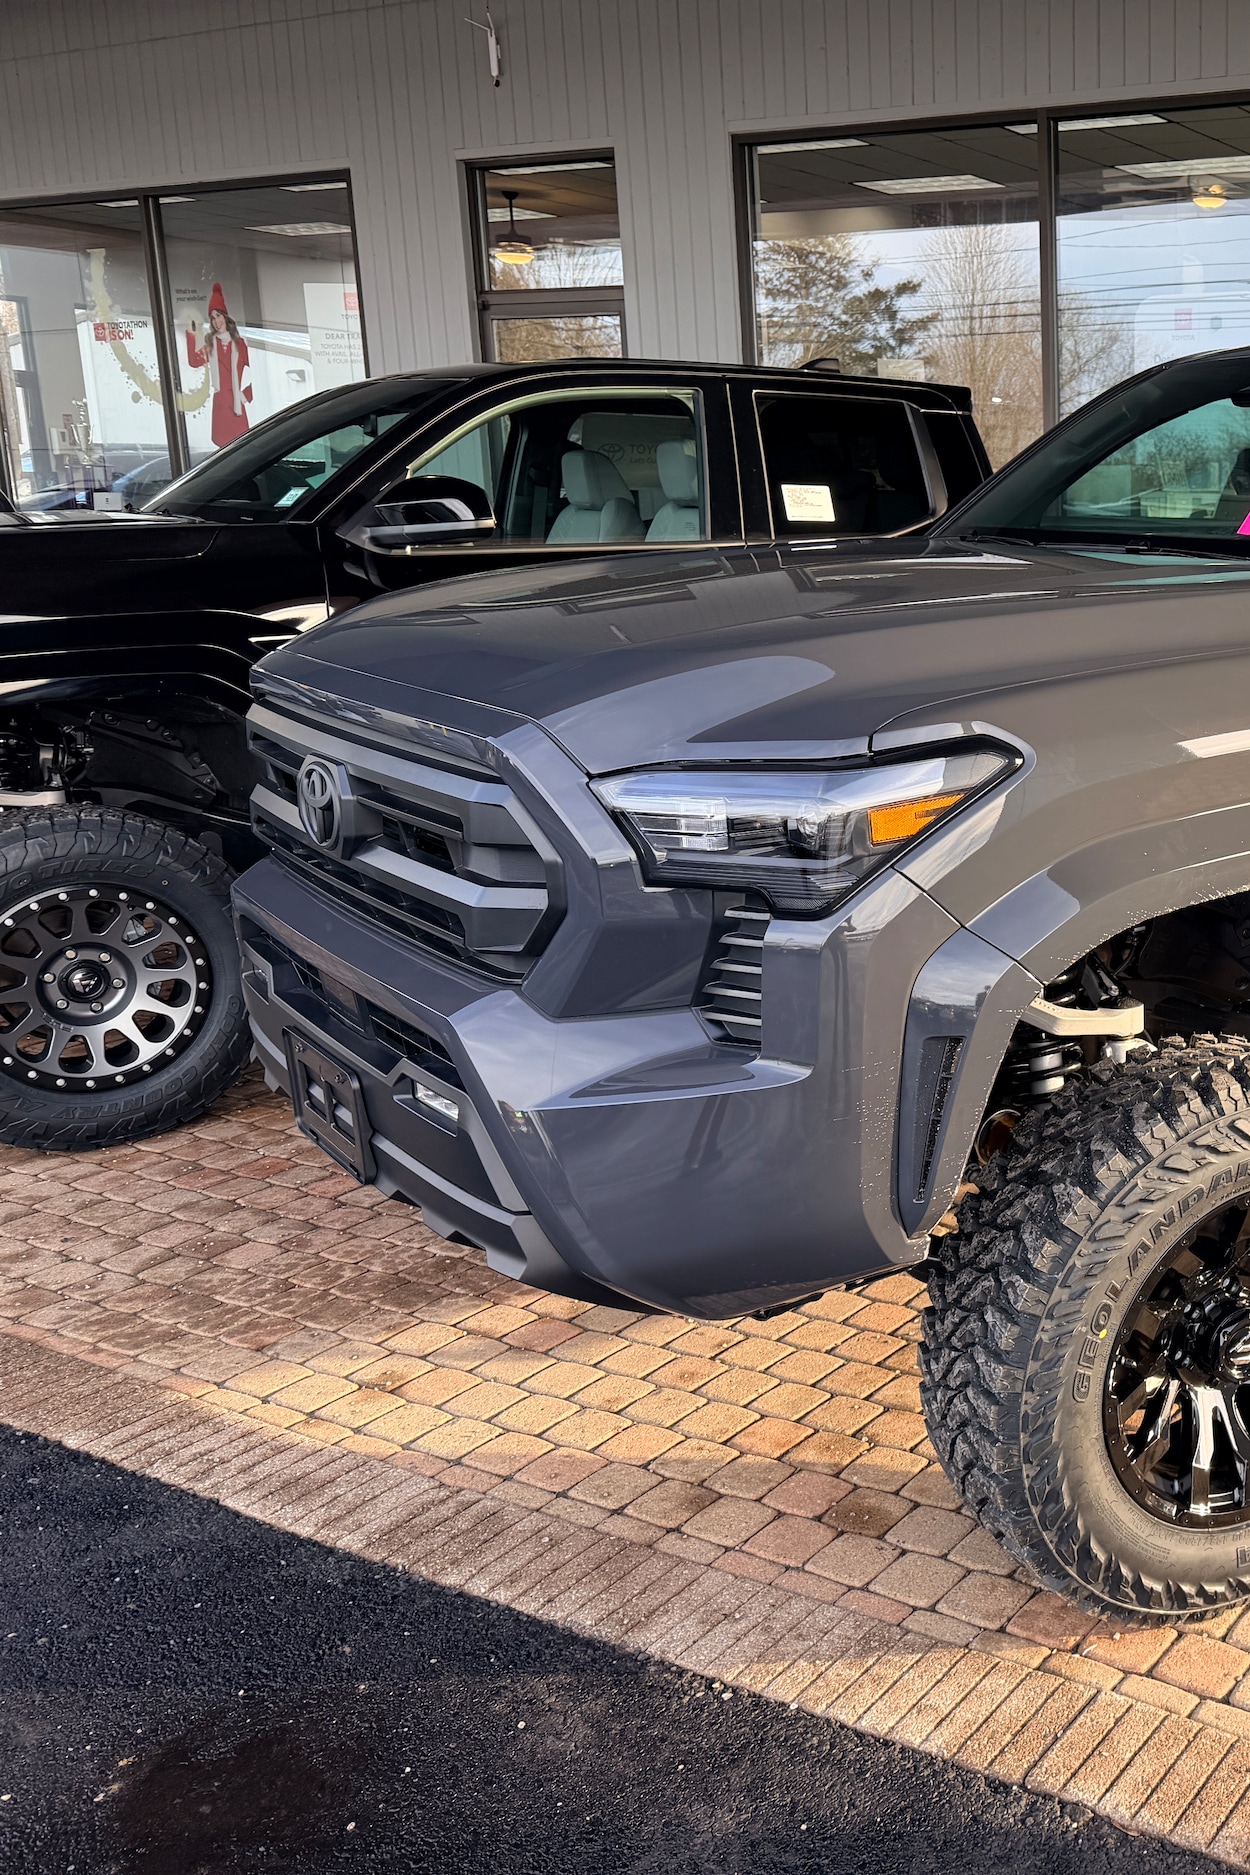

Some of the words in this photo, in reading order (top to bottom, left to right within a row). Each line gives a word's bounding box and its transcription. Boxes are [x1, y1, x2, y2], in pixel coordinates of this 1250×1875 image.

[106, 320, 148, 330] TOYOTATHON
[118, 329, 134, 341] ON!
[38, 858, 155, 879] TIRES
[199, 994, 243, 1063] OPEN
[51, 1065, 198, 1120] COUNTRY
